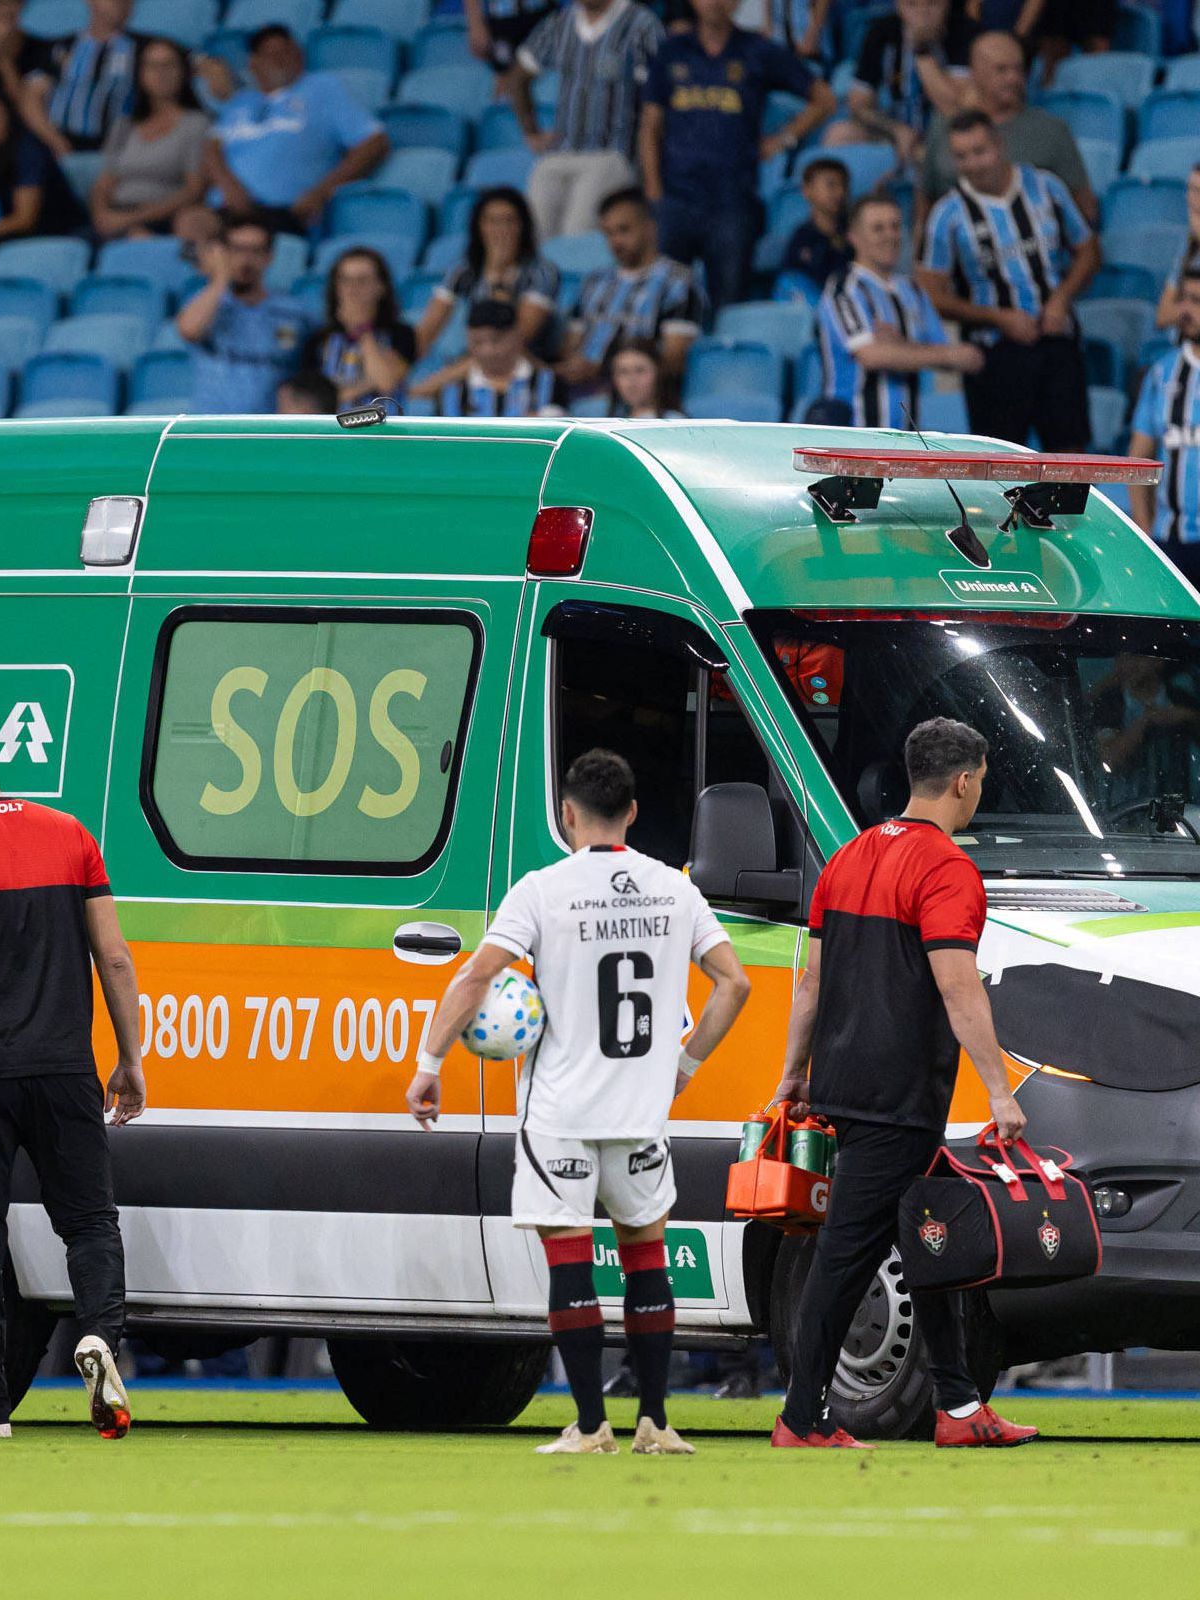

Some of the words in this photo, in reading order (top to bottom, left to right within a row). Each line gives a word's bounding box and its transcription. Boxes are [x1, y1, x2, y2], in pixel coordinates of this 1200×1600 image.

[954, 580, 1019, 594] Unimed
[200, 666, 428, 819] SOS
[569, 901, 607, 911] ALPHA
[579, 920, 592, 942] E.
[596, 915, 670, 941] MARTINEZ
[598, 950, 654, 1058] 6
[138, 993, 230, 1060] 0800
[244, 996, 320, 1061] 707
[333, 997, 437, 1063] 0007
[810, 1182, 829, 1212] G
